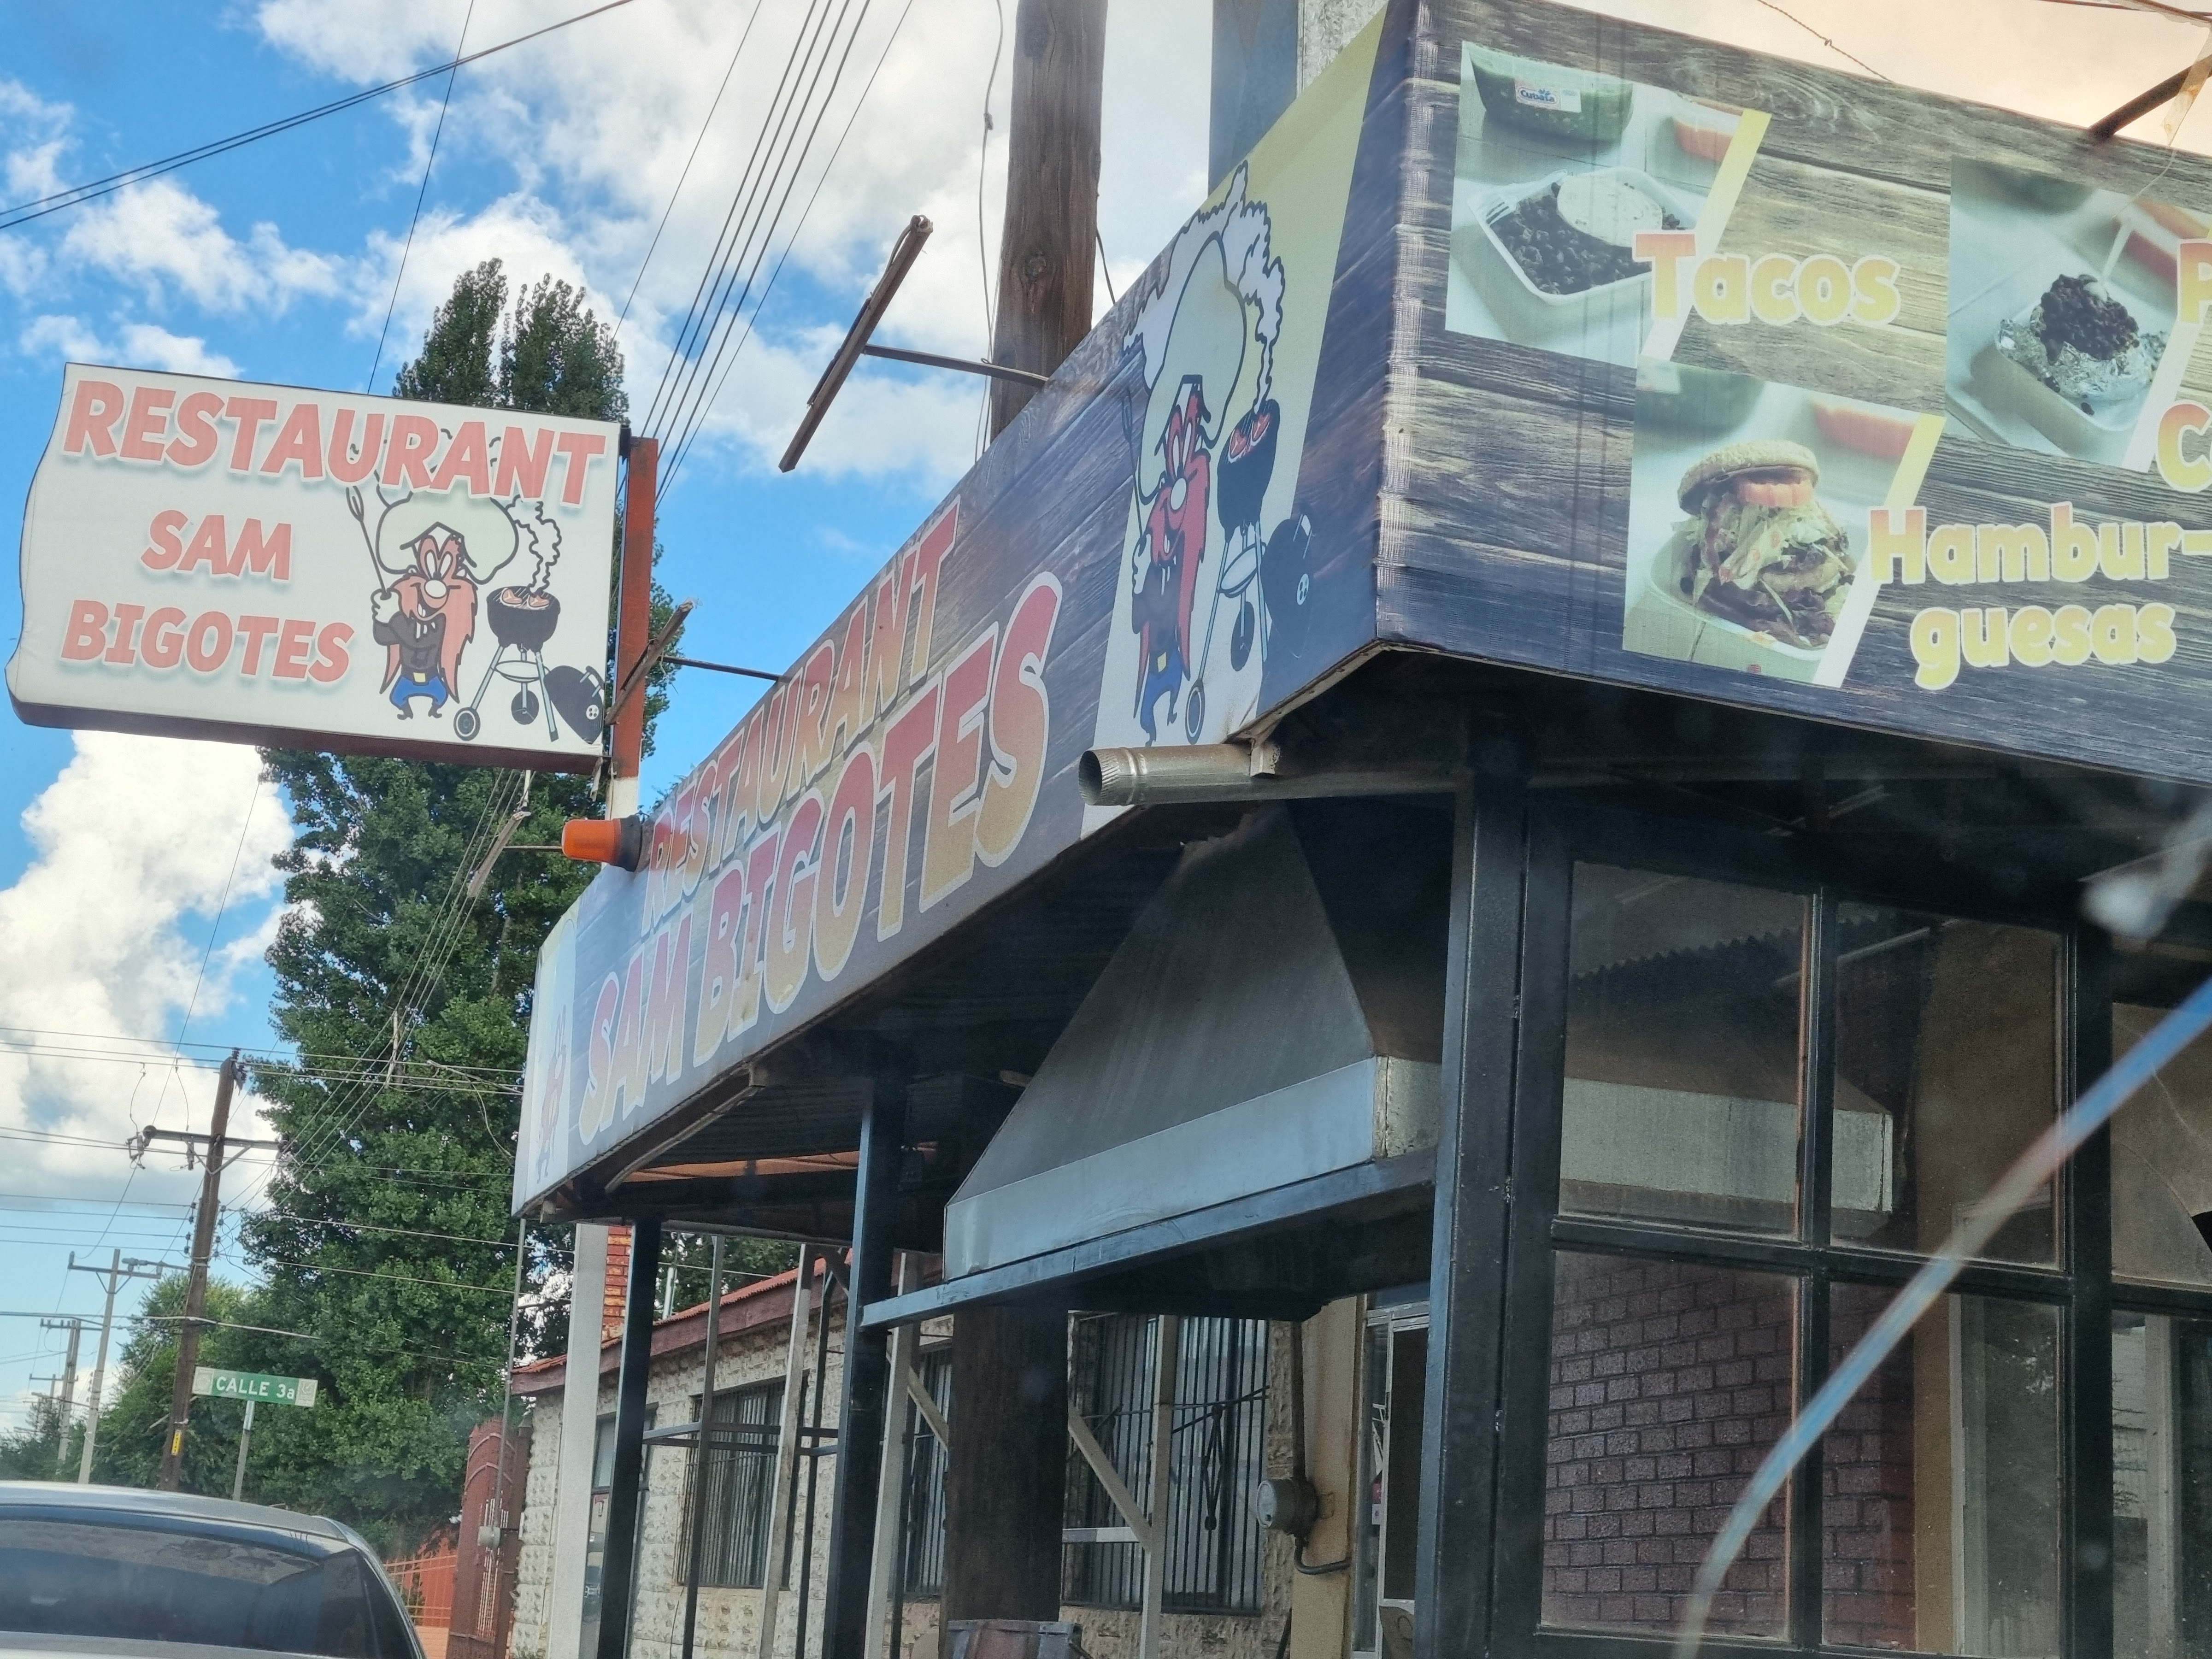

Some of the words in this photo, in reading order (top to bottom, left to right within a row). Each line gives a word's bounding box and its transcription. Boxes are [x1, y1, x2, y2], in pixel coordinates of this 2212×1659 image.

[1633, 229, 1901, 325] Tacos
[63, 380, 606, 506] RESTAURANT
[140, 509, 293, 582] SAM
[60, 599, 356, 684] BIGOTES
[1909, 602, 2177, 690] guesas
[641, 494, 961, 937] RESTAURANT
[579, 908, 692, 1145] SAM
[693, 571, 1063, 1068] BIGOTES
[216, 1376, 270, 1396] CALLE
[276, 1384, 295, 1400] 3a
